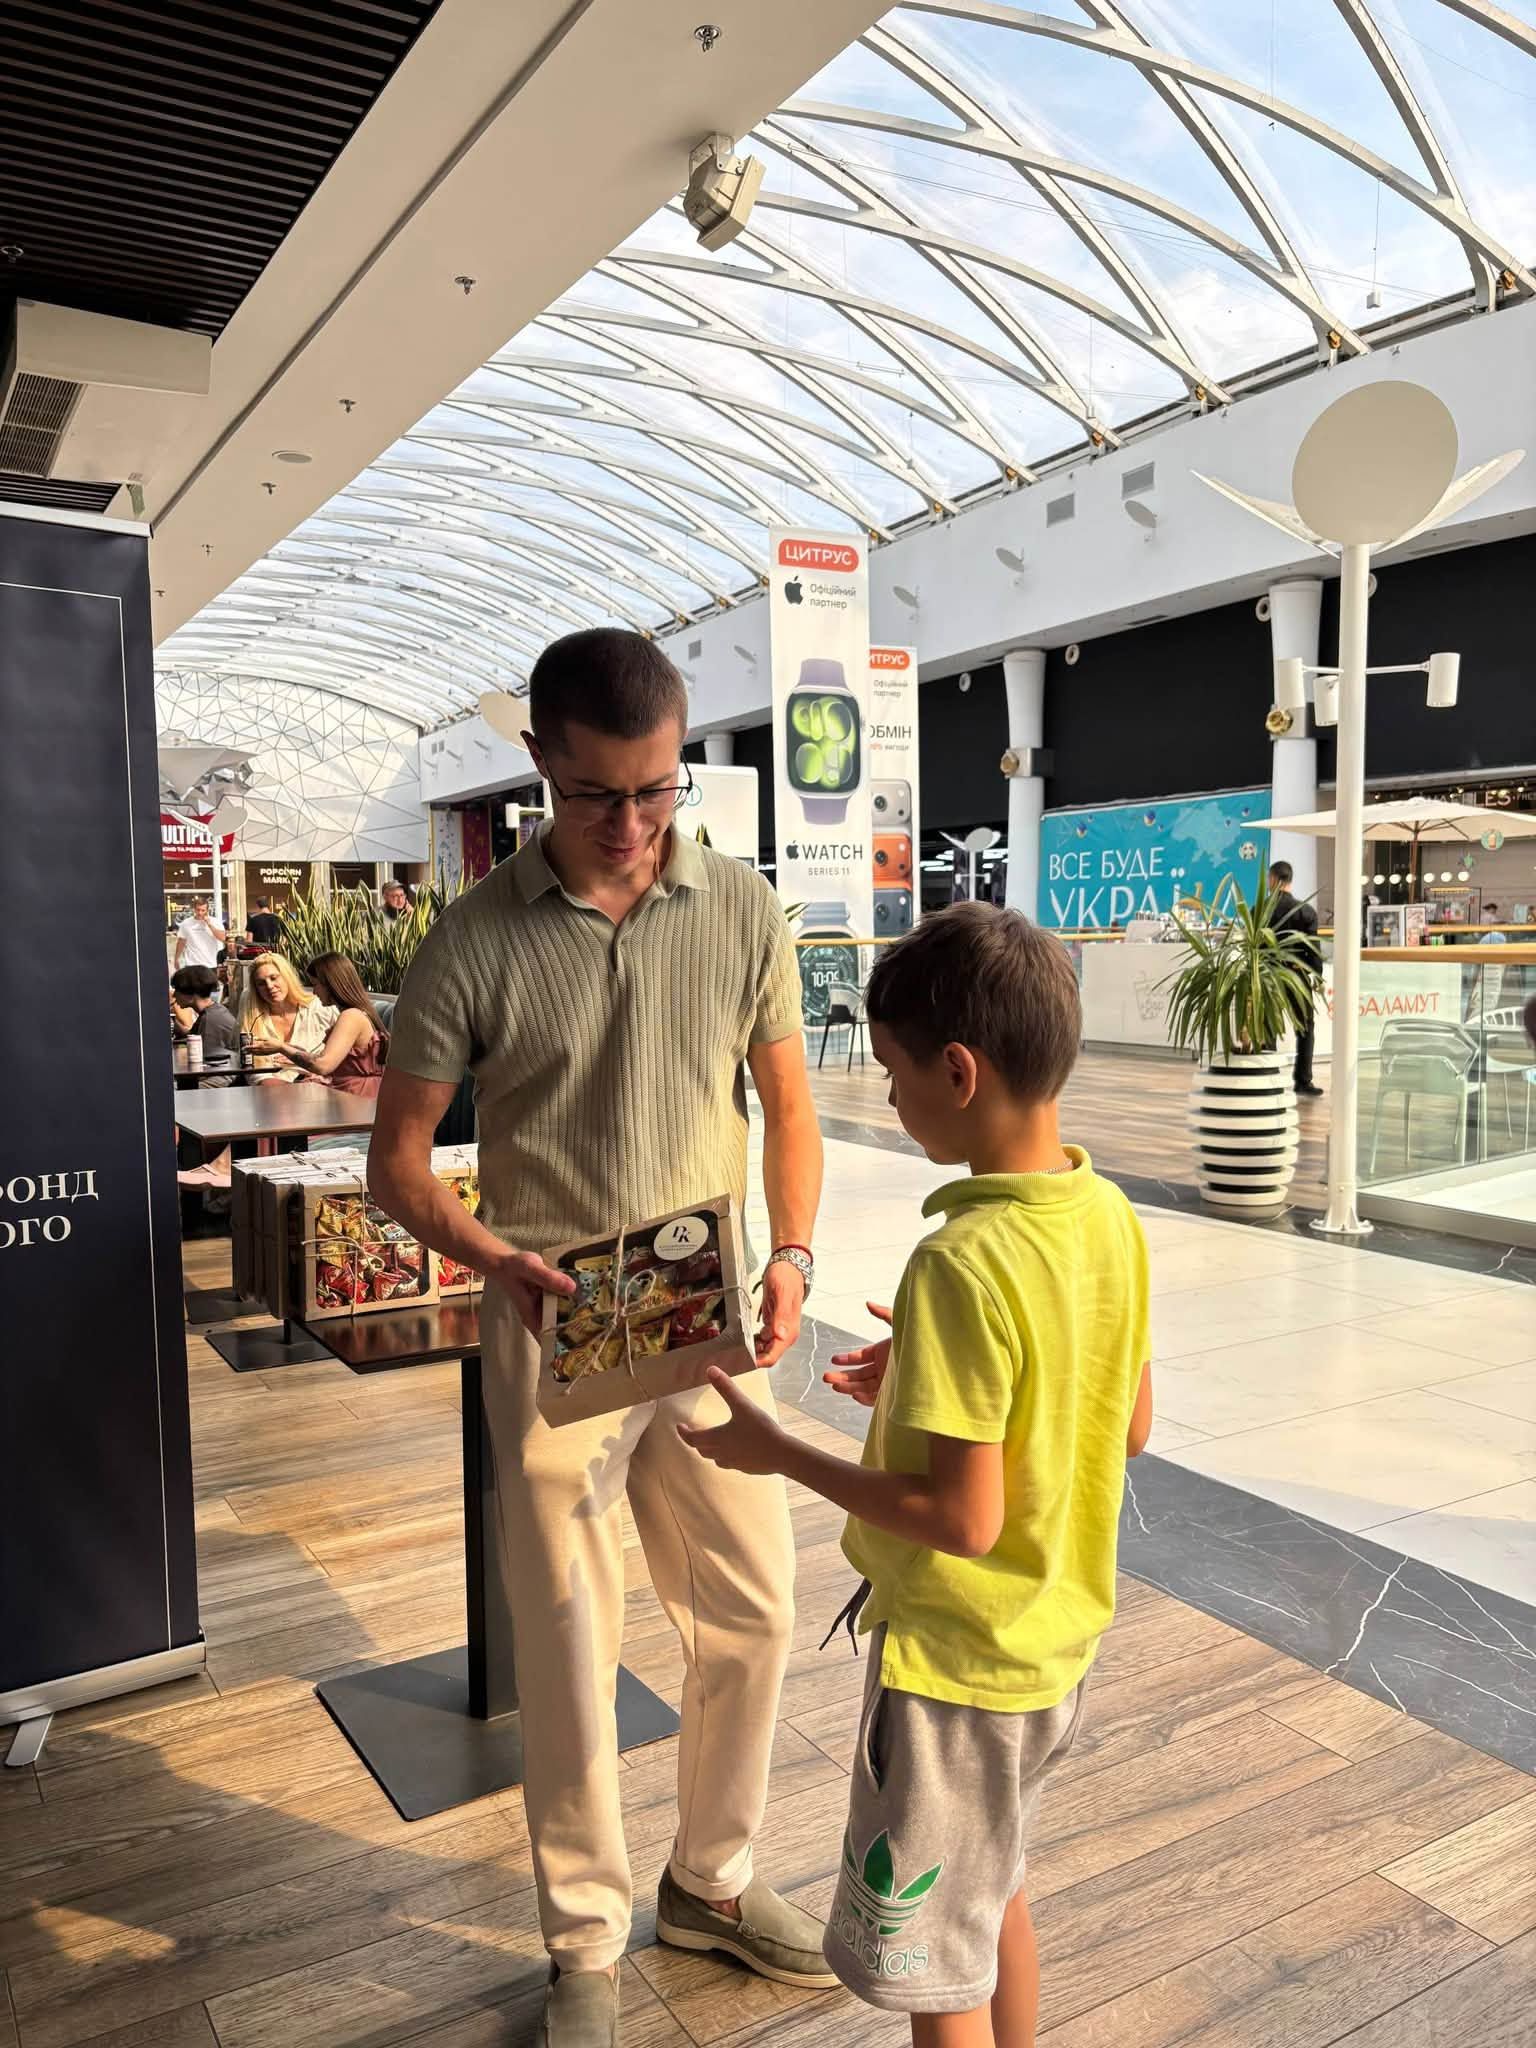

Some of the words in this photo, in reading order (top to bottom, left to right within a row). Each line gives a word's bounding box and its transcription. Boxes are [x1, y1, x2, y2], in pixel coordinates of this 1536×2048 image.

[785, 544, 852, 566] ЦИТРУС
[810, 598, 848, 610] партнер
[870, 653, 905, 666] ИТРУС
[802, 844, 863, 860] WATCH
[1050, 852, 1093, 881] ВСЕ
[1101, 846, 1165, 881] БУДЕ
[808, 866, 840, 876] SERIES
[841, 866, 850, 876] 11
[263, 876, 299, 884] MARKT
[0, 1169, 99, 1204] ОНД
